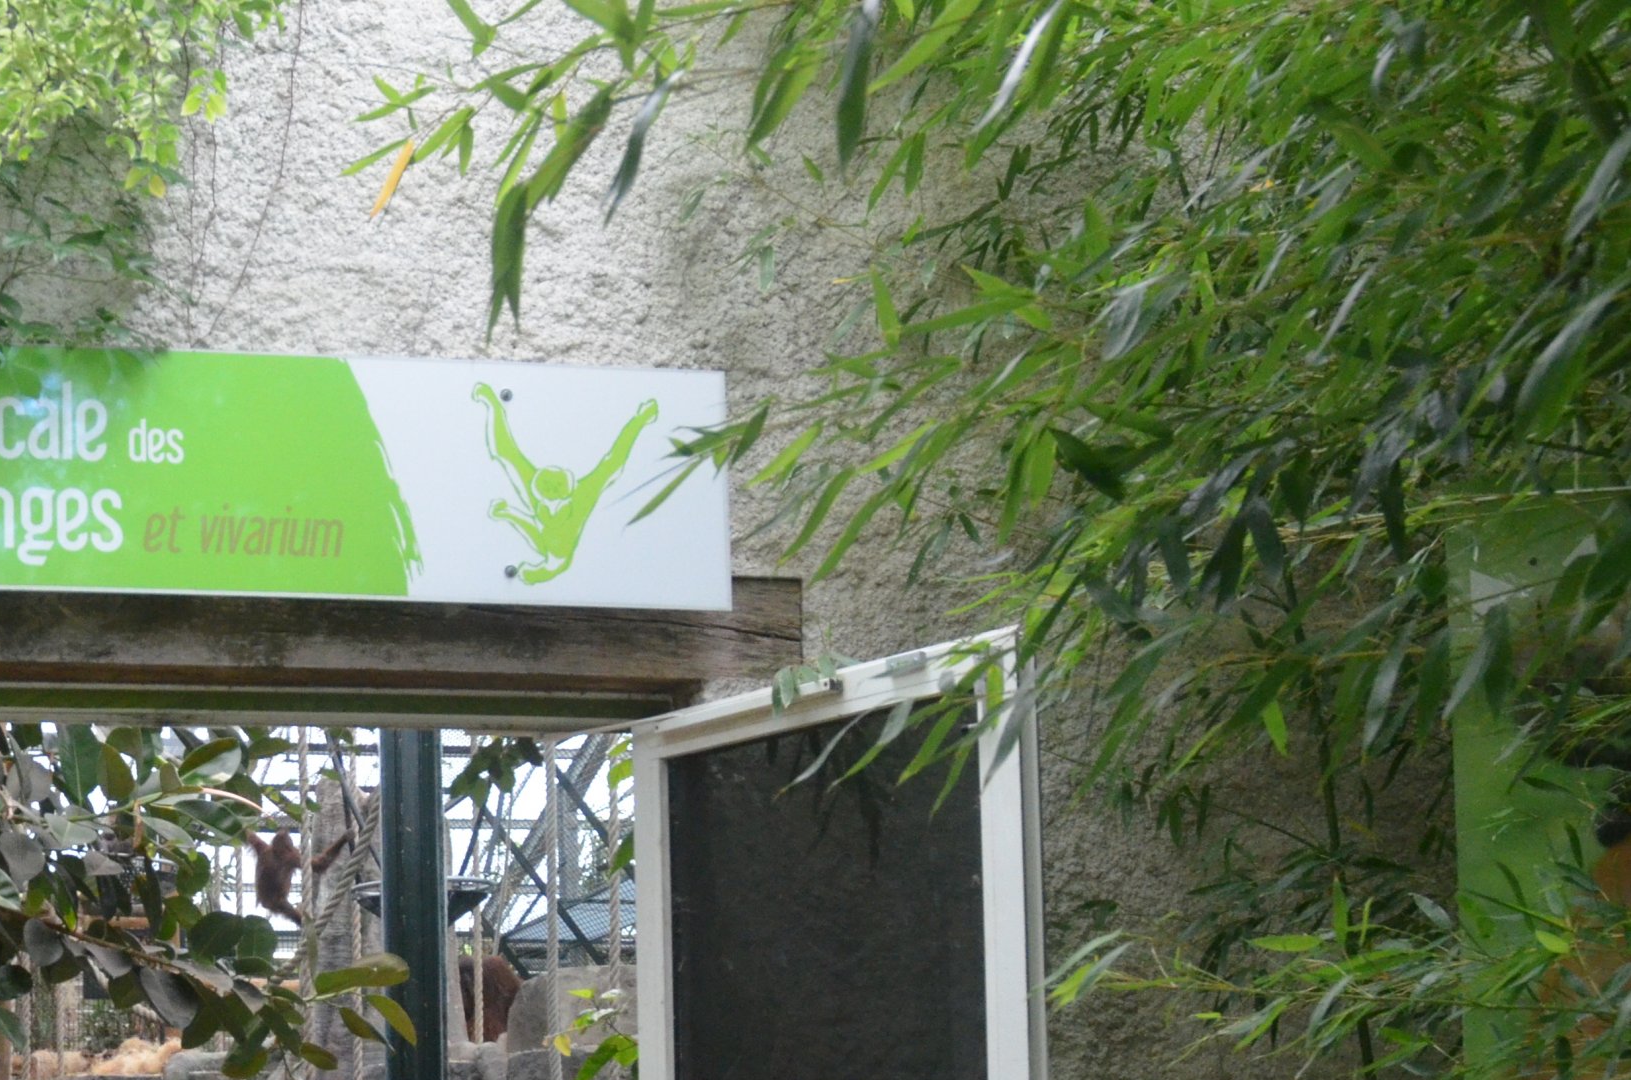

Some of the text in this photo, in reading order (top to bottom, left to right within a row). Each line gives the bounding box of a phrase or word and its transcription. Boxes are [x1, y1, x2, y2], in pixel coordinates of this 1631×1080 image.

[128, 418, 185, 464] des
[143, 505, 186, 553] et
[199, 503, 345, 558] vivarium
